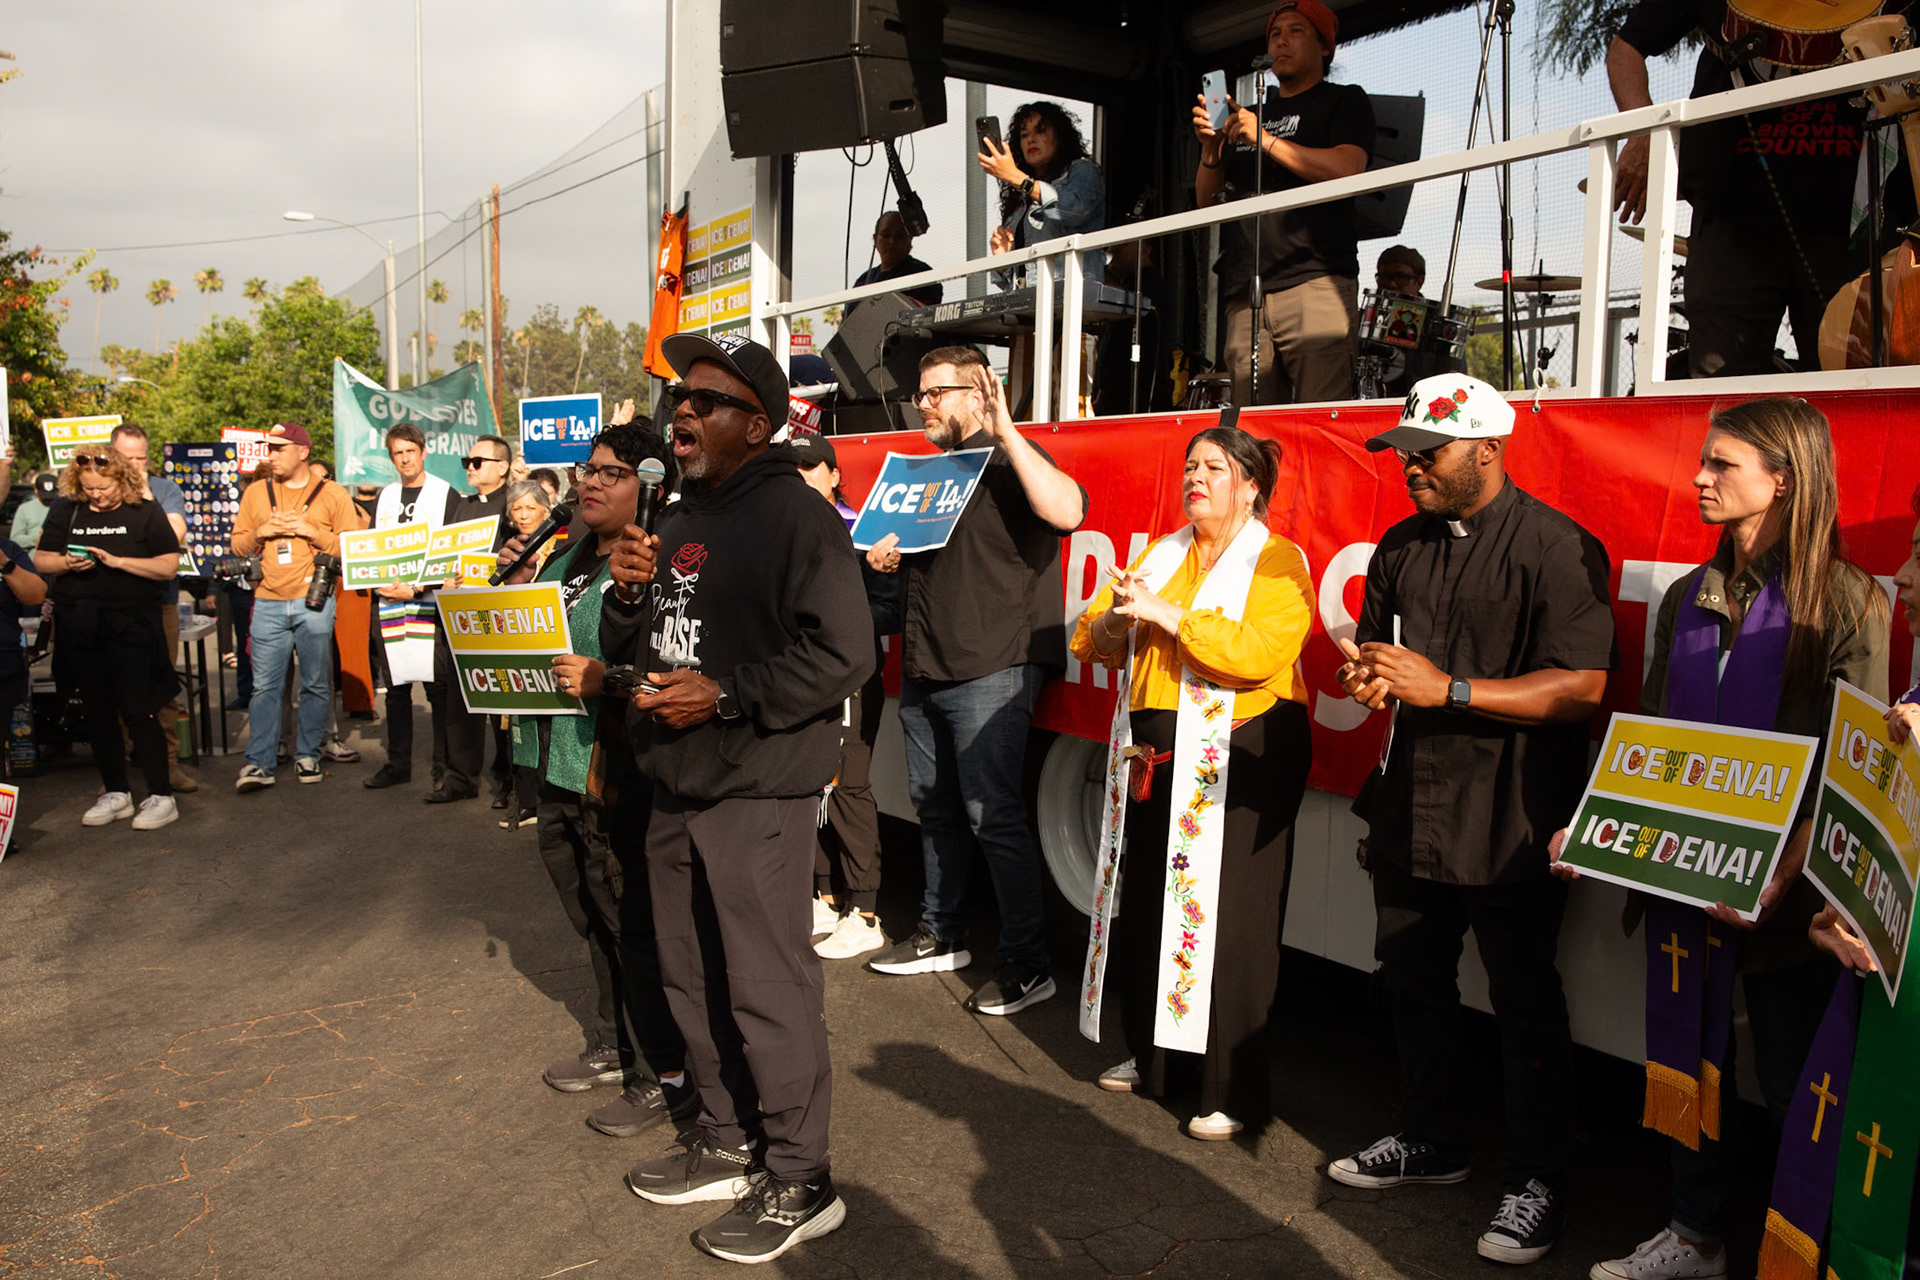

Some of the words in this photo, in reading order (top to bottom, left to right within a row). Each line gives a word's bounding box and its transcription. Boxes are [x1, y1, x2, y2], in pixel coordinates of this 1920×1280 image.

[1781, 111, 1813, 123] OF
[1820, 112, 1835, 123] A
[1757, 123, 1855, 138] BROWN
[728, 252, 750, 273] DENA!
[934, 302, 962, 323] KORG
[964, 300, 985, 309] TRITON
[369, 395, 424, 421] GOD
[523, 418, 556, 441] ICE
[569, 415, 597, 440] LA!
[869, 482, 926, 513] ICE
[923, 483, 942, 497] OUT
[936, 479, 976, 514] LA!
[919, 498, 933, 513] OF
[350, 539, 376, 554] ICE
[385, 529, 426, 550] DENA!
[432, 536, 452, 550] ICE
[457, 526, 492, 545] DENA!
[351, 565, 379, 579] ICE
[388, 559, 424, 577] DENA
[464, 563, 490, 579] ICE
[651, 583, 690, 621] Beauty
[448, 610, 482, 635] ICE
[490, 606, 556, 635] DENA!
[464, 668, 501, 692] ICE
[506, 668, 566, 693] DENA
[1608, 741, 1668, 781] ICE
[1665, 750, 1687, 768] OUT
[1838, 719, 1884, 784] ICE
[1880, 748, 1897, 775] OUT
[1663, 767, 1680, 783] OF
[1680, 752, 1792, 803] DENA!
[1878, 770, 1890, 794] OF
[1580, 815, 1642, 855] ICE
[1637, 826, 1661, 844] OUT
[1820, 812, 1861, 879] ICE
[1633, 842, 1651, 859] OF
[1650, 829, 1764, 886] DENA!
[1858, 844, 1873, 872] OUT
[1854, 868, 1865, 889] OF
[1863, 856, 1907, 955] DENA!
